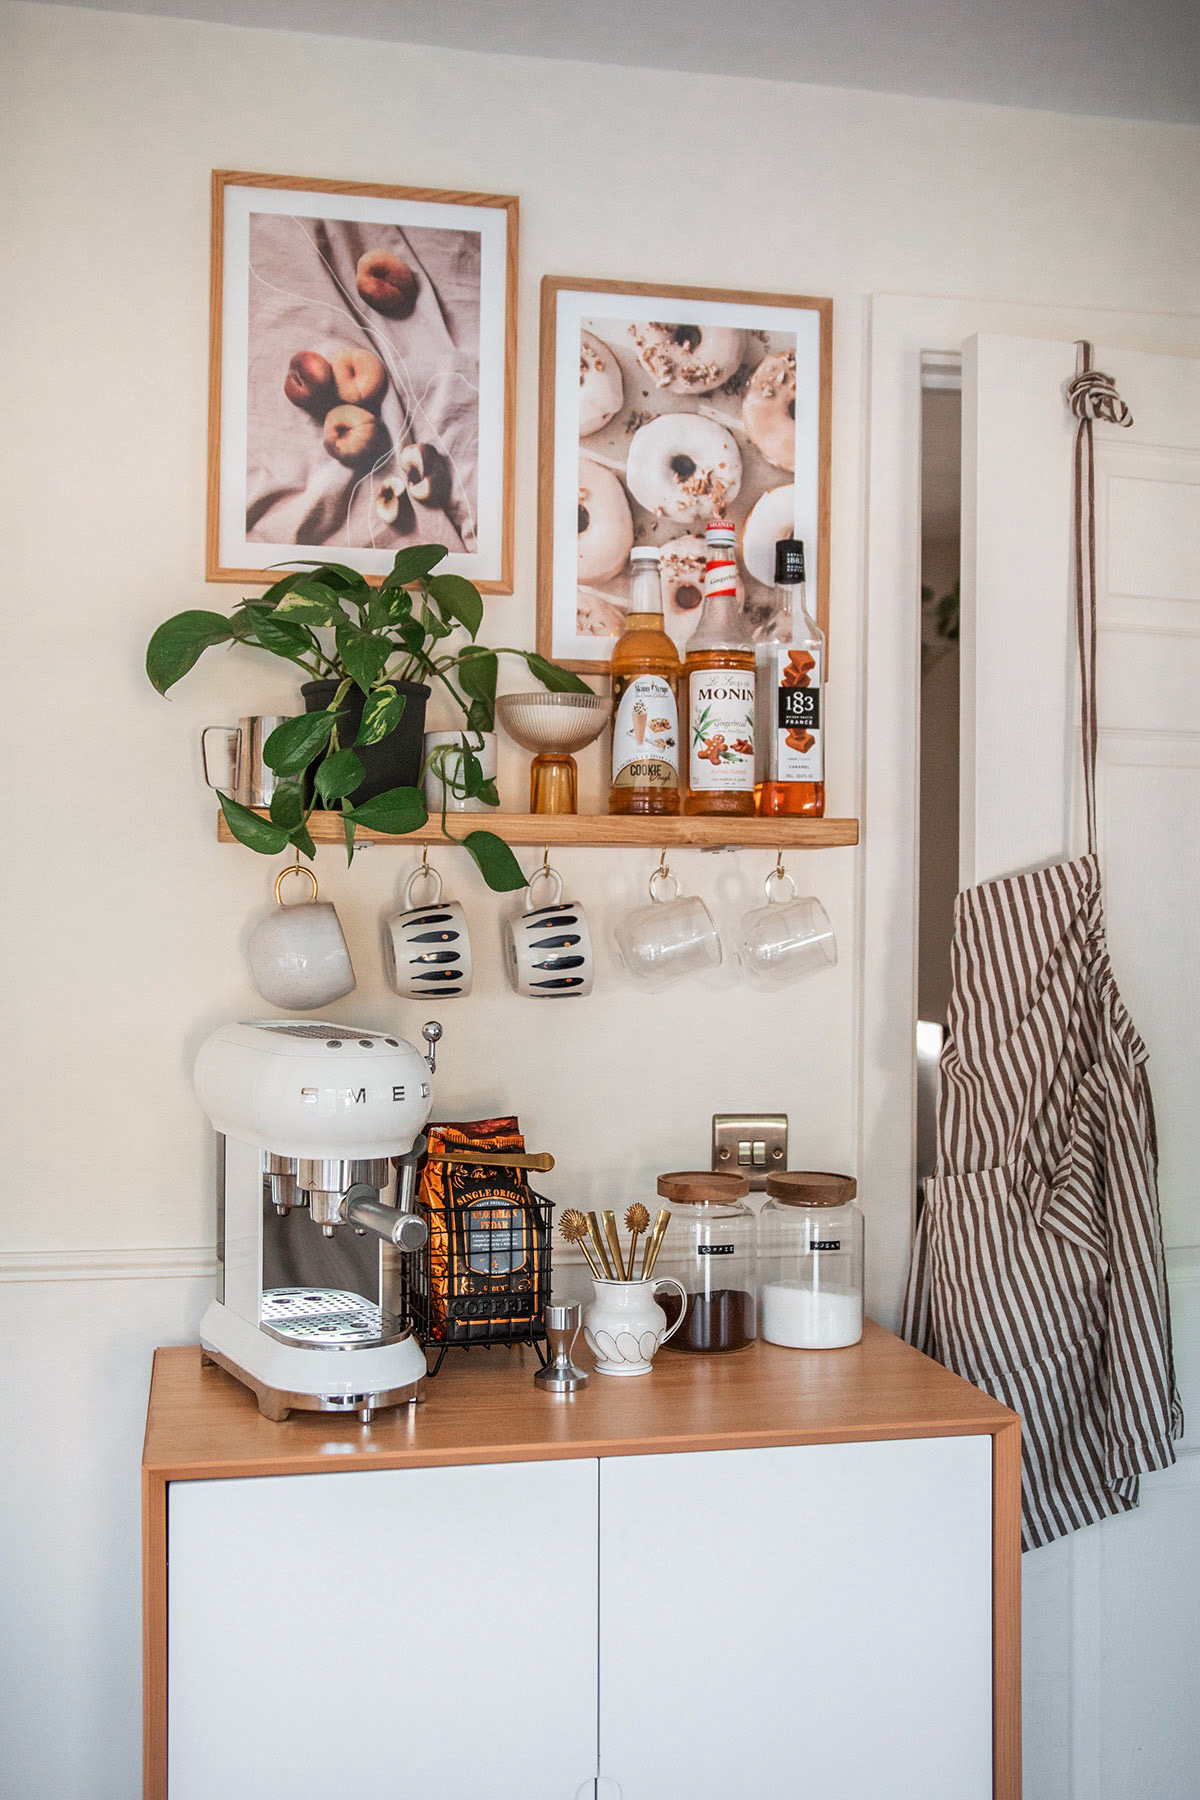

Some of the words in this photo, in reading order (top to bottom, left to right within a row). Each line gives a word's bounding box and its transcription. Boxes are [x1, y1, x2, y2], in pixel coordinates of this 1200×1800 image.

[698, 688, 754, 700] MONIN
[630, 764, 662, 777] COOKIE
[456, 1189, 492, 1206] SINGLE
[493, 1189, 526, 1204] ORIGIN
[702, 1246, 734, 1254] COFFEE
[451, 1298, 529, 1316] COFFEE
